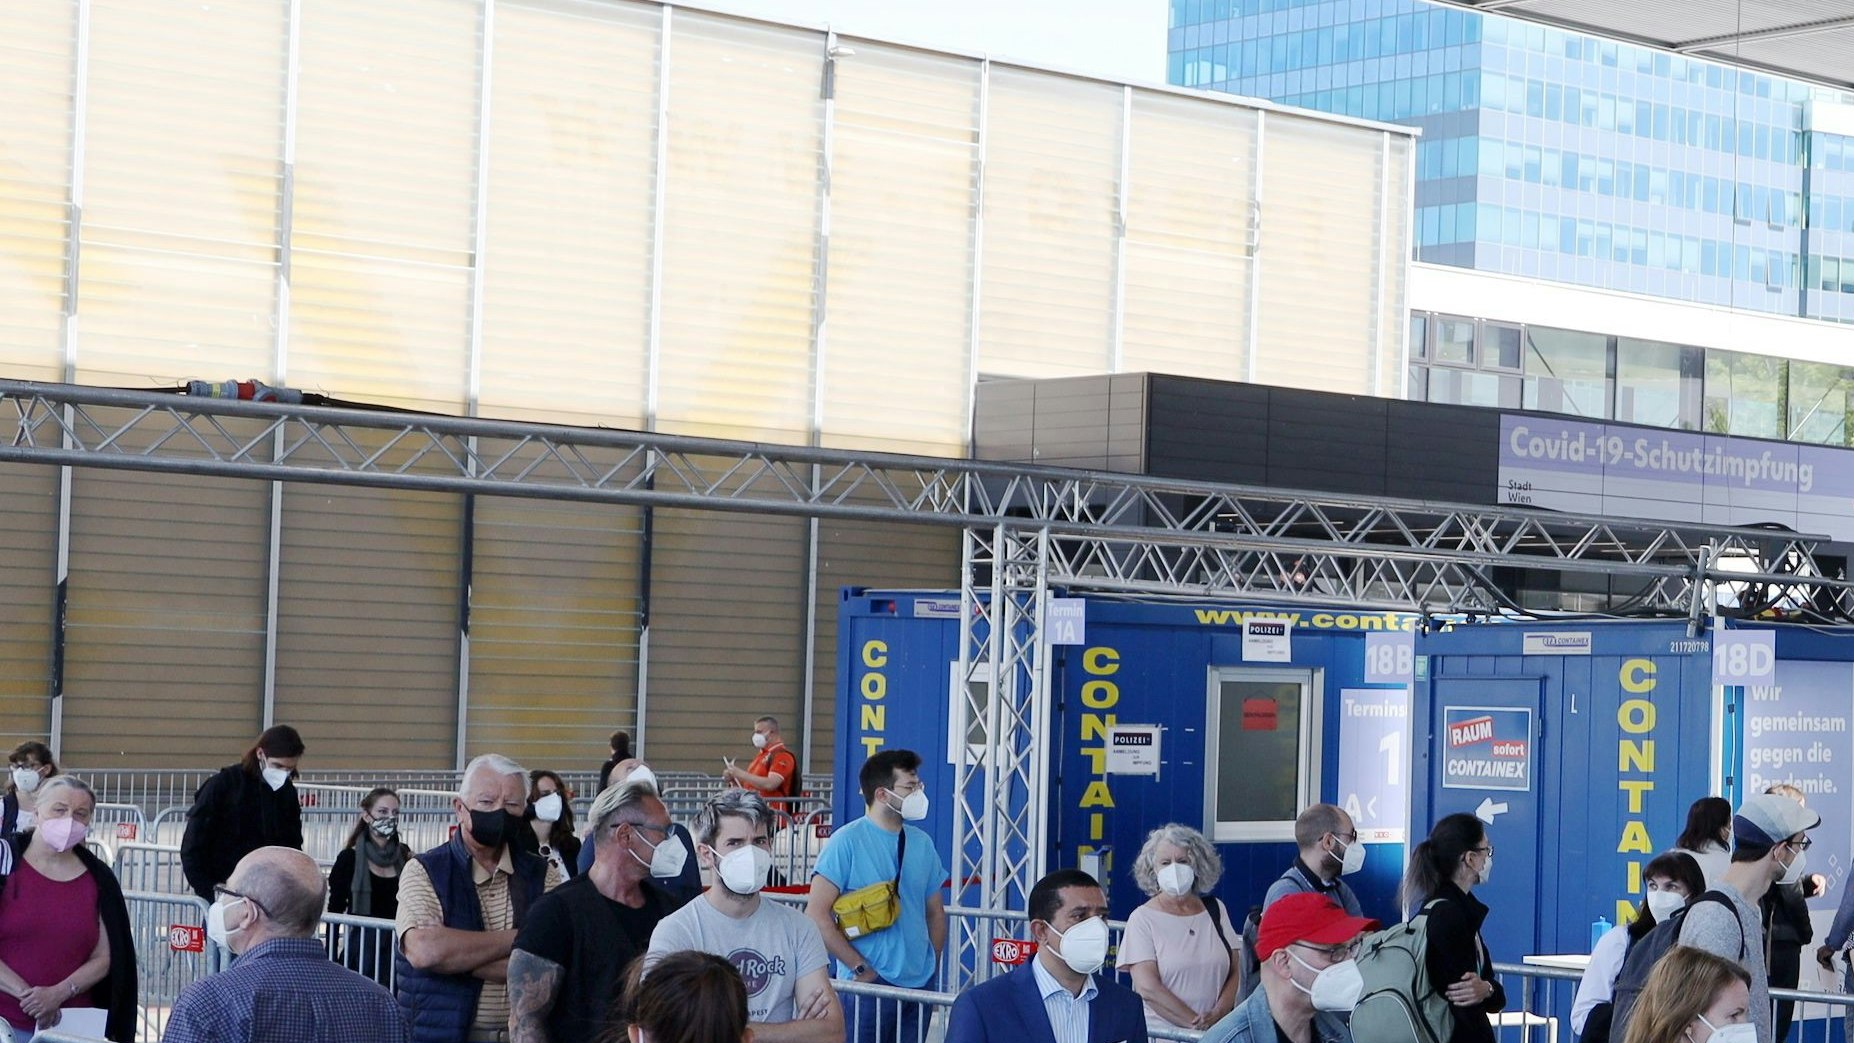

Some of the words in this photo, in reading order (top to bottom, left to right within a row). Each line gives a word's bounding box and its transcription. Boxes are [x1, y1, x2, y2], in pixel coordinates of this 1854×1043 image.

[1510, 426, 1813, 491] Covid-19-Schutzimpfung
[1508, 480, 1532, 491] Stadt
[1508, 492, 1532, 503] Wien
[1048, 603, 1083, 618] Termin
[1055, 619, 1076, 641] 1A
[1250, 626, 1279, 634] POLIZEI
[1670, 641, 1709, 653] 211720798
[1367, 644, 1412, 675] 18B
[1714, 642, 1773, 677] 18D
[1345, 699, 1408, 718] Termins
[1452, 721, 1492, 745] RAUM
[1750, 711, 1845, 737] gemeinsam
[1114, 736, 1146, 744] POLIZEI
[1493, 743, 1524, 756] sofort
[1750, 747, 1802, 769] gegen
[1807, 742, 1832, 763] die
[1448, 758, 1525, 778] CONTAINEX
[994, 943, 1017, 960] EKRO
[746, 955, 786, 978] Rock
